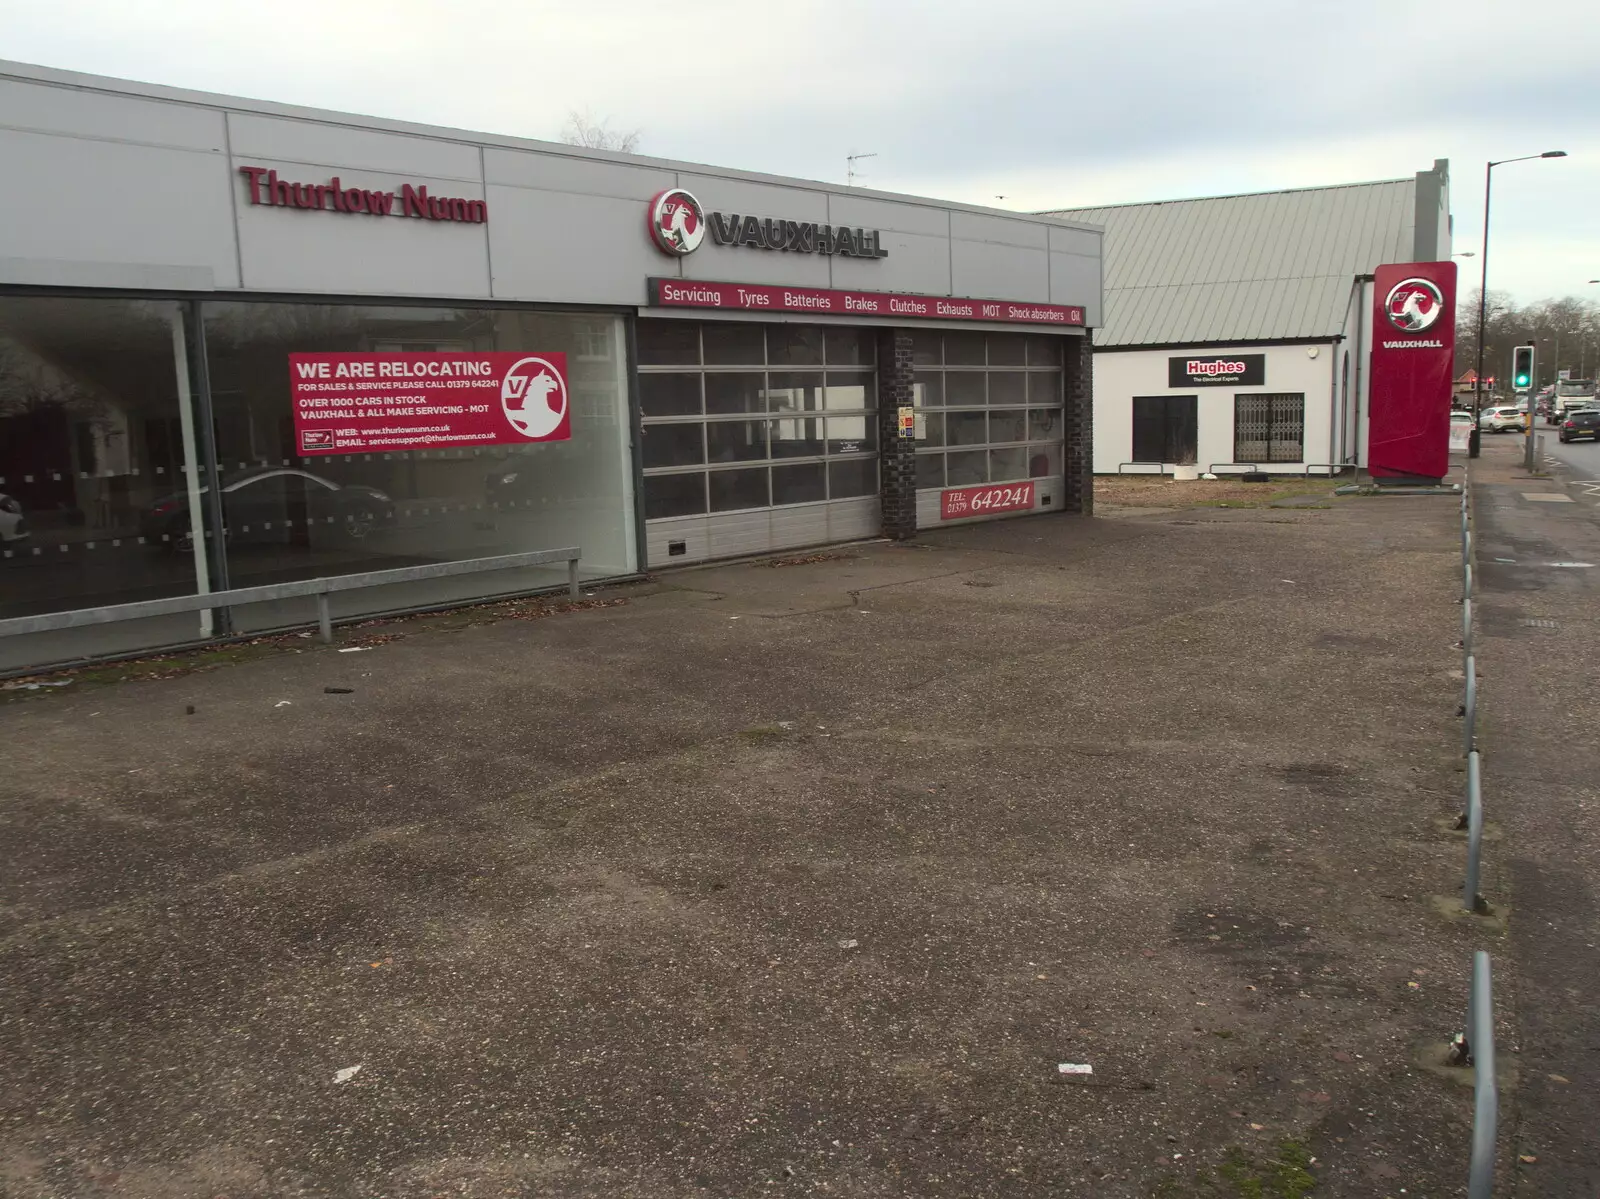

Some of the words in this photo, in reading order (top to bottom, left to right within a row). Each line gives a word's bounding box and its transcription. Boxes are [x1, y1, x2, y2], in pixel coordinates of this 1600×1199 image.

[239, 165, 395, 216] Thurlow
[402, 183, 488, 224] Nunn
[709, 212, 889, 258] VAUXHALL
[664, 284, 721, 306] Servicing
[737, 289, 770, 307] Tyres
[784, 292, 831, 308] Batteries
[844, 296, 878, 311] Brakes
[889, 299, 927, 313] Clutches
[936, 302, 973, 316] Exhausts
[982, 305, 1000, 317] MOT
[1008, 306, 1030, 319] Shock
[1030, 309, 1064, 321] absorbers
[1070, 310, 1081, 321] Oil
[1382, 340, 1443, 348] VAUXHALL
[296, 362, 331, 379] WE
[335, 362, 376, 378] ARE
[379, 361, 493, 378] RELOCATING
[1187, 360, 1245, 376] Hughes
[298, 383, 317, 391] FOR
[318, 383, 347, 391] SALES
[348, 382, 355, 391] &
[356, 382, 393, 390] SERVICE
[393, 381, 424, 389] PLEASE
[425, 381, 446, 389] CALL
[446, 380, 470, 388] 01379
[471, 380, 499, 388] 642241
[299, 399, 329, 408] OVER
[330, 398, 354, 407] 1000
[355, 397, 383, 406] CARS
[383, 397, 395, 405] IN
[395, 396, 427, 405] STOCK
[300, 410, 356, 420] VAUXHALL
[357, 409, 366, 418] &
[366, 408, 386, 417] ALL
[386, 407, 415, 416] MAKE
[415, 406, 464, 416] SERVICING
[470, 405, 489, 413] MOT
[336, 429, 359, 437] WEB:
[361, 424, 451, 435] www.thurlownunn.co.uk
[336, 438, 366, 448] EMAIL:
[368, 432, 496, 446] servicesupport@thurlownunn.co.uk
[948, 492, 966, 502] TEL:
[971, 486, 1030, 510] 642241
[947, 502, 968, 513] 01379
